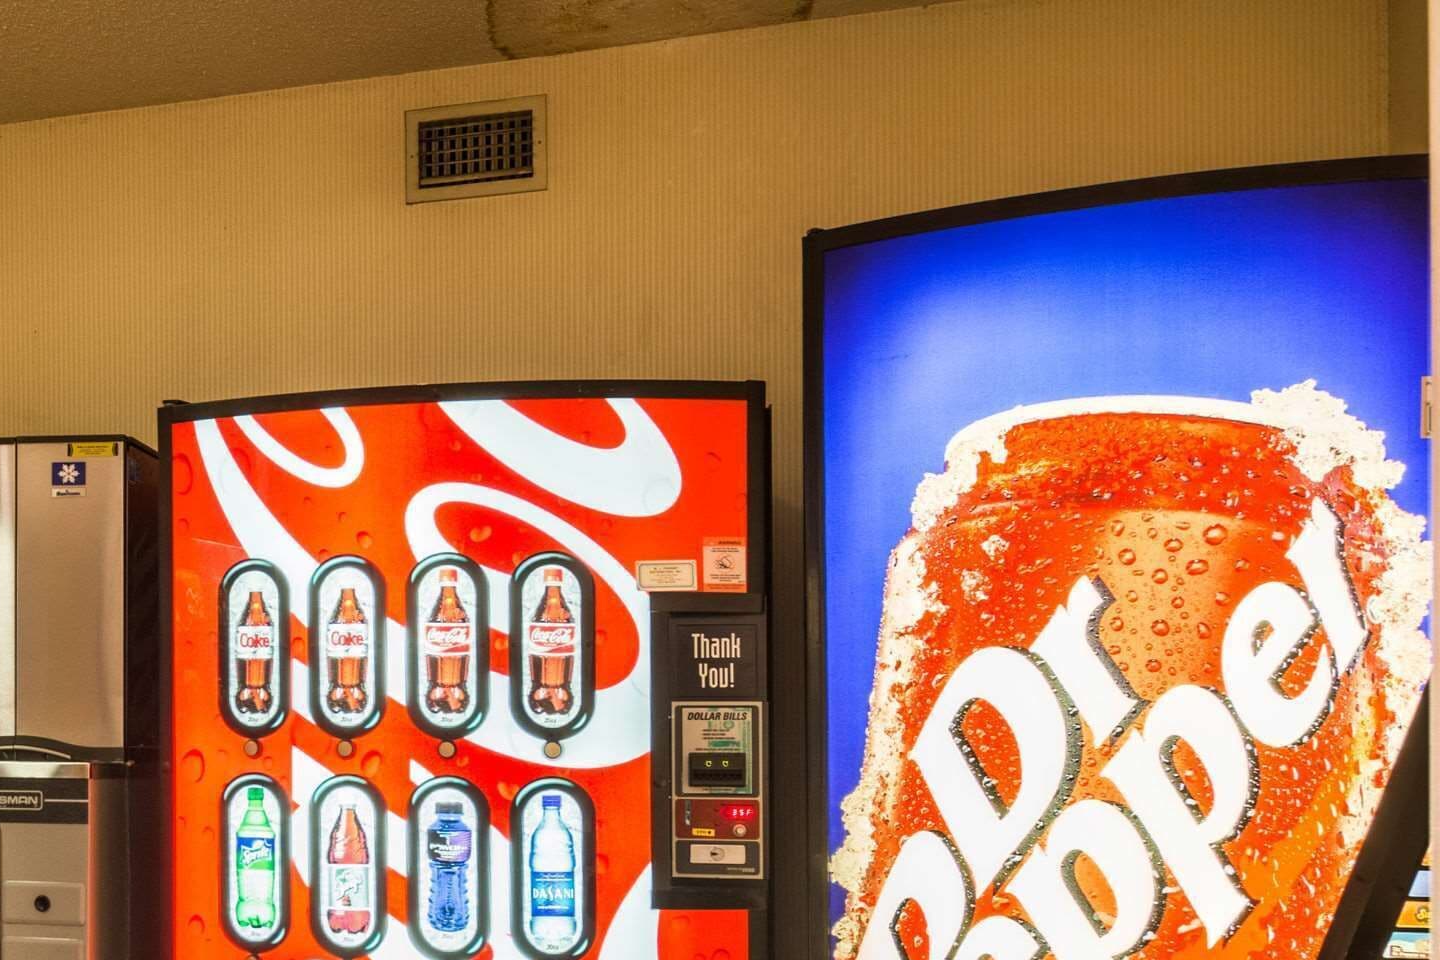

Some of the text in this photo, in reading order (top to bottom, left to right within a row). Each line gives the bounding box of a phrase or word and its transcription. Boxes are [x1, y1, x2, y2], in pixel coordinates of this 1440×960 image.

[240, 632, 270, 648] Coke
[331, 631, 364, 646] Coke
[692, 632, 741, 659] Thank
[699, 663, 734, 688] You!
[687, 711, 748, 721] DOLLAR BILLS
[910, 575, 1152, 895] Dr
[532, 887, 574, 901] DASANI
